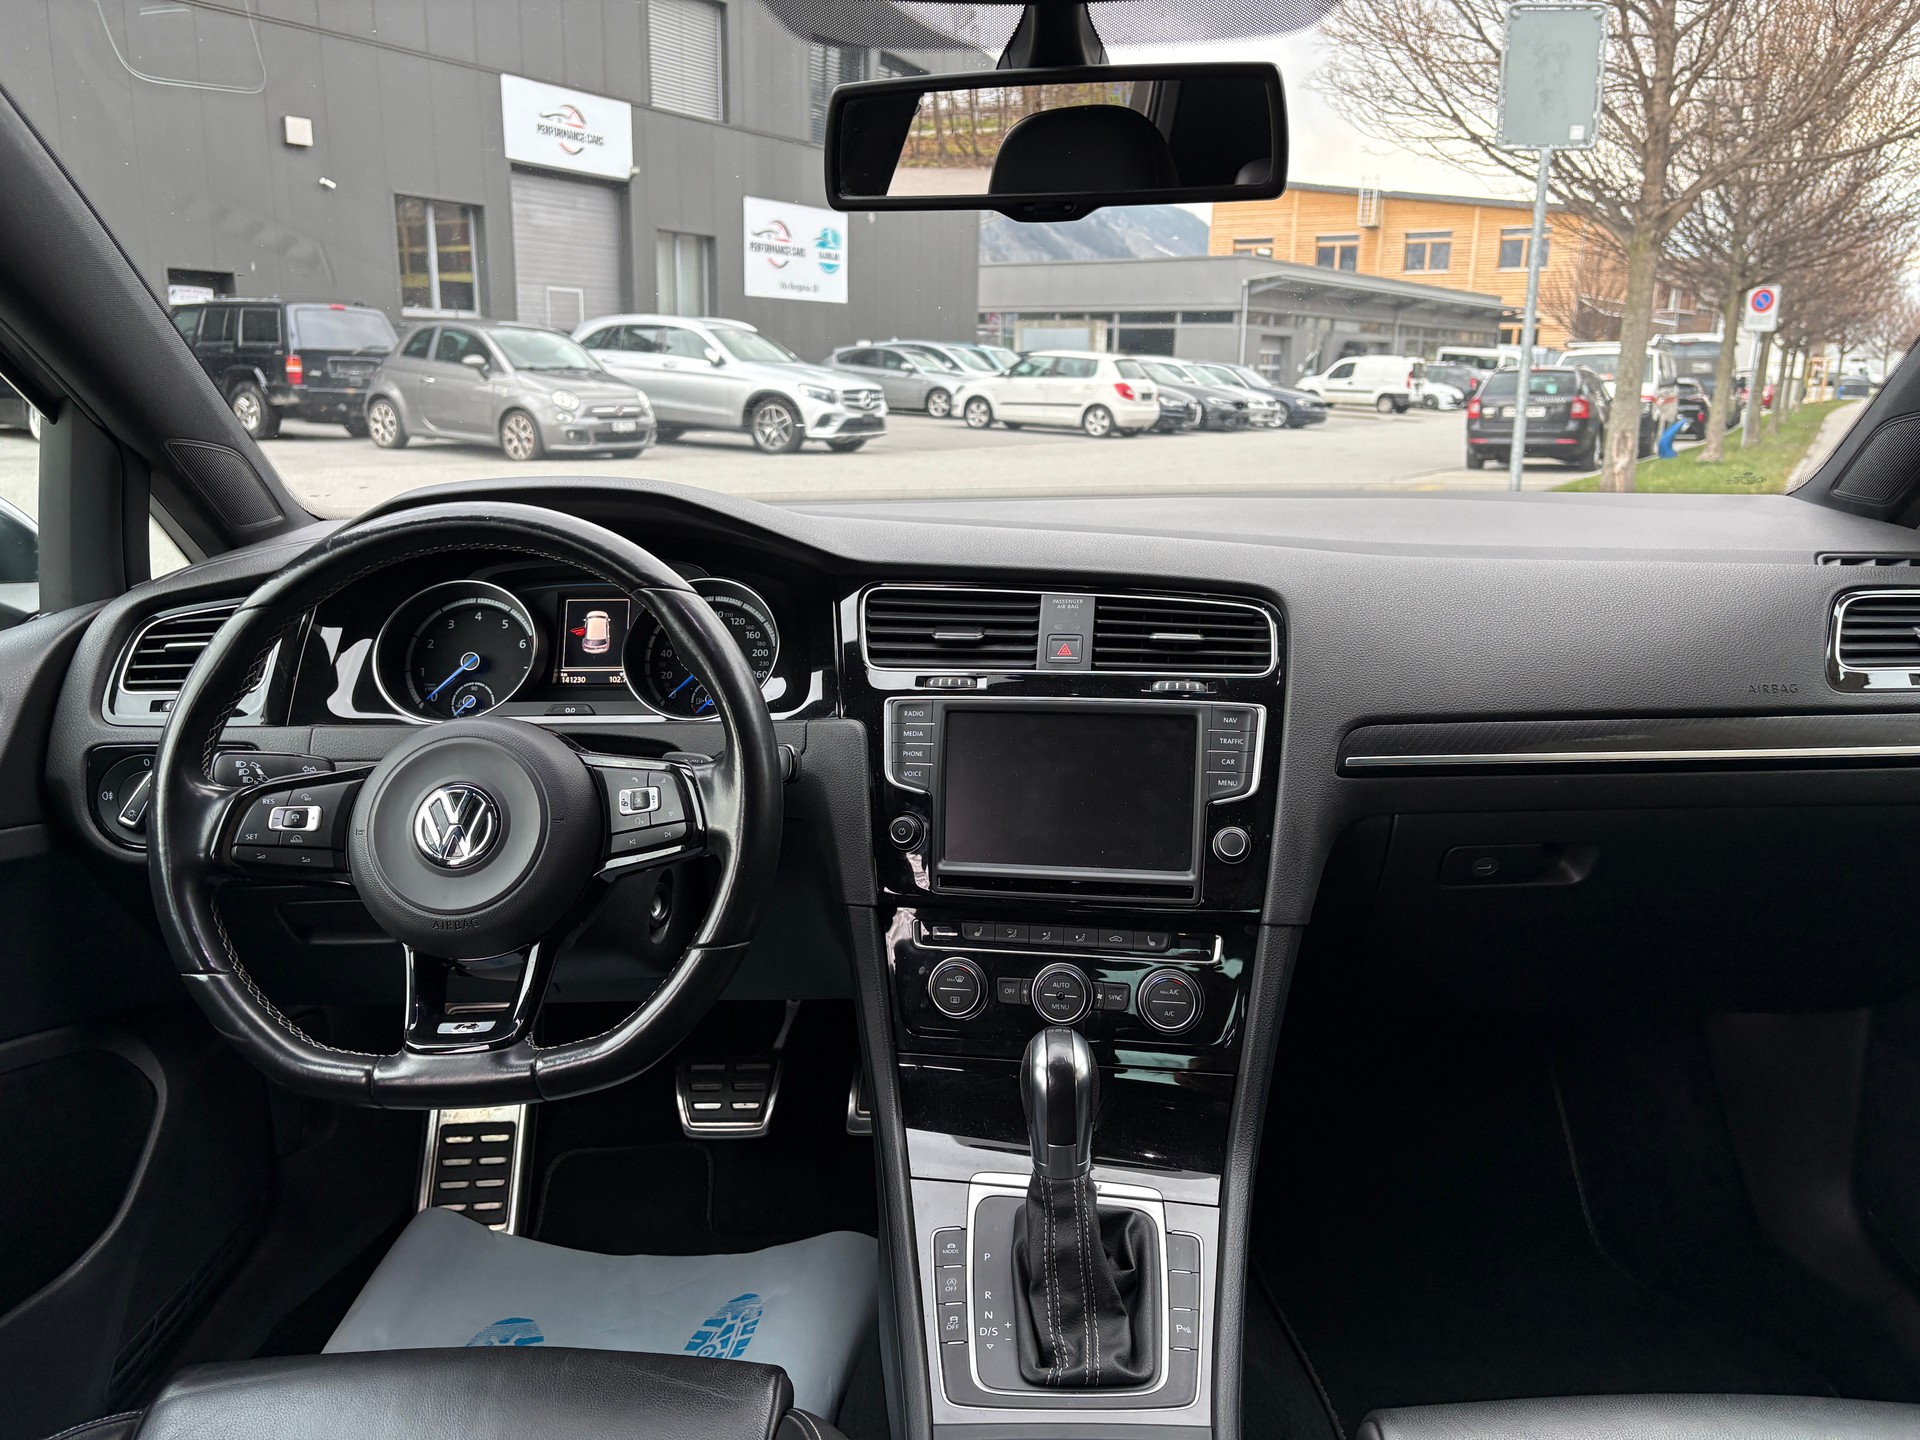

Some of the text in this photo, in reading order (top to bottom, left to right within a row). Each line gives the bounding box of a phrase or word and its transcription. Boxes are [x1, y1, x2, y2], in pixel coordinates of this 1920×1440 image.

[475, 612, 482, 621] 4
[448, 620, 455, 629] 3
[502, 620, 509, 629] 5
[730, 617, 746, 626] 120
[745, 631, 761, 639] 160
[427, 640, 434, 649] 2
[519, 640, 526, 649] 6
[660, 649, 673, 658] 40
[752, 649, 769, 657] 200
[420, 667, 425, 677] 1
[660, 671, 673, 680] 20
[562, 676, 586, 684] 141230
[1749, 684, 1798, 694] AIRBAG
[432, 918, 480, 931] AIRBAG
[984, 1252, 991, 1261] P
[984, 1290, 992, 1300] R
[984, 1310, 993, 1320] N
[979, 1326, 999, 1337] D/S
[1176, 1324, 1183, 1333] P
